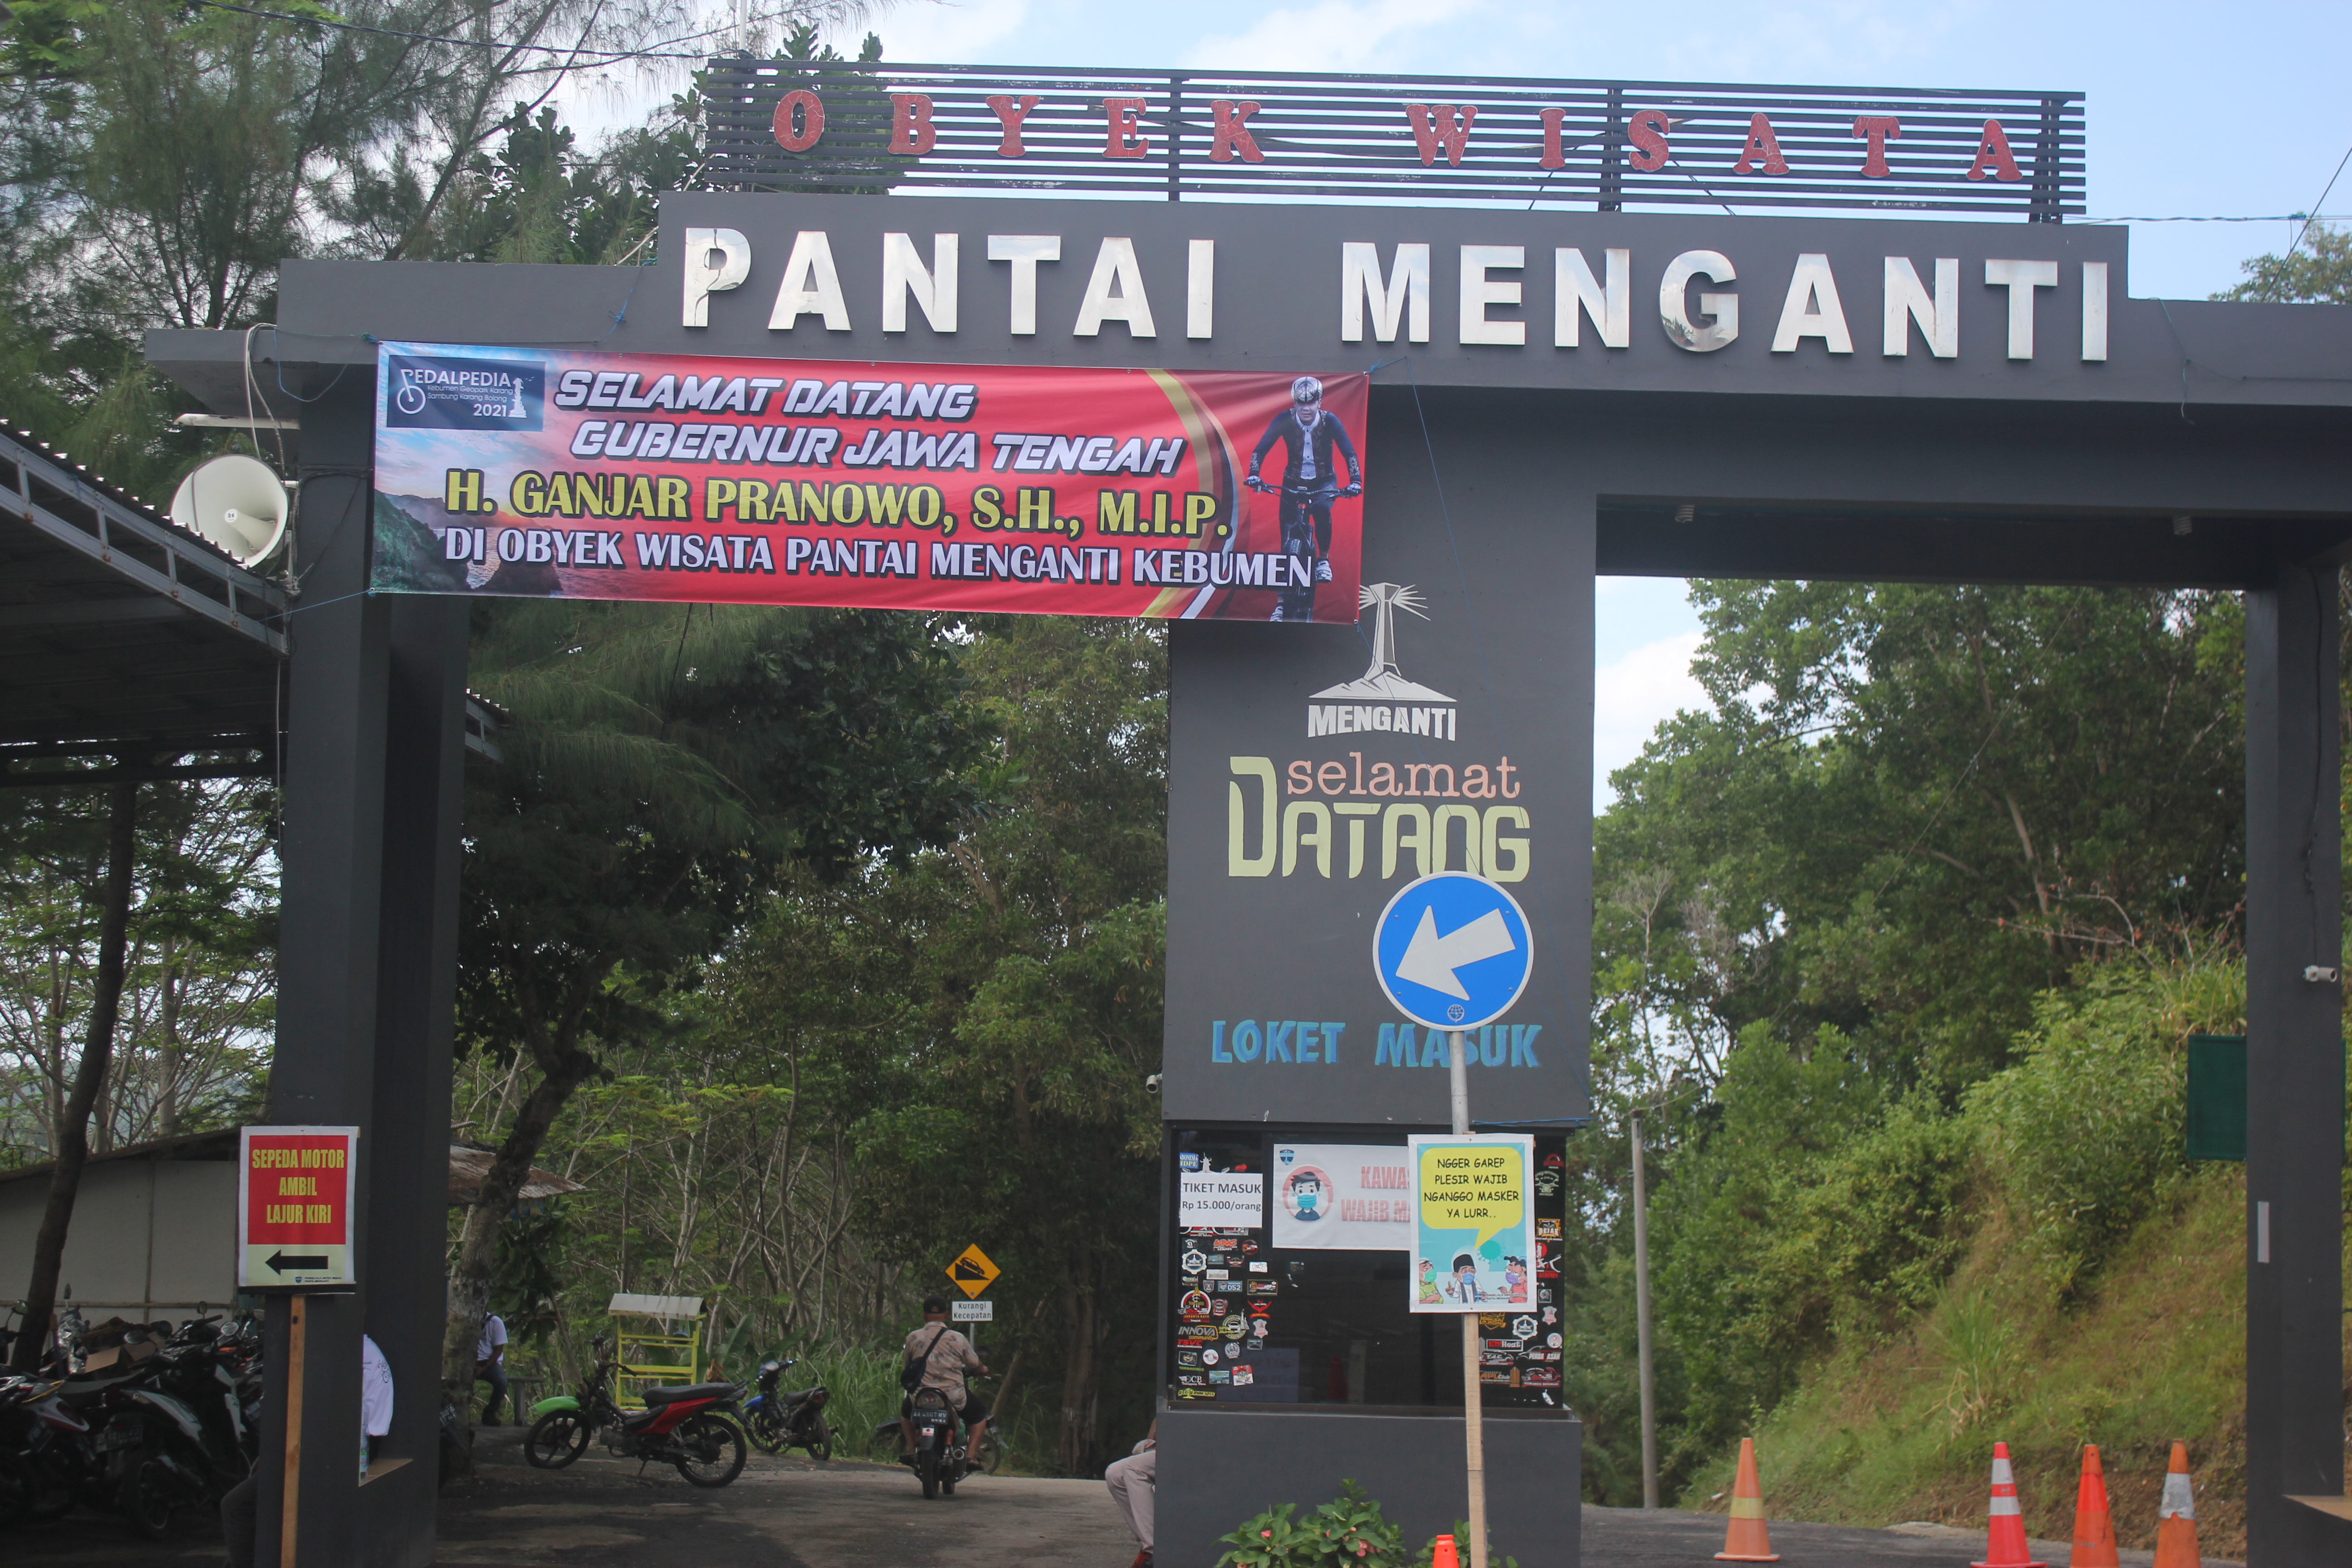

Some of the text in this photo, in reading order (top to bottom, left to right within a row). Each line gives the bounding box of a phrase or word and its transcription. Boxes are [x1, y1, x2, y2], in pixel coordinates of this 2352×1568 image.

[773, 89, 2023, 182] OBYEK WISATA
[682, 227, 2107, 362] PANTAI MENGANTI
[460, 386, 489, 394] Geopark
[460, 393, 483, 402] Karang
[485, 395, 507, 403] Bolong
[555, 371, 976, 418] SELAMAT DATANG
[473, 403, 507, 417] 2021
[570, 421, 1184, 473] GUBERNUR JAWA TENGAH
[447, 471, 1230, 537] H. GANJAR PRANOWO, S.H., M.I.P.
[446, 528, 1312, 588] DI OBYEK WISATA PANTAI MENGANTI KEBUMEN
[1308, 705, 1456, 742] MENGANTI
[1287, 752, 1521, 799] selamat
[1212, 1019, 1543, 1068] LOKET MASUK
[252, 1149, 345, 1169] SEPEDA MOTOR
[1437, 1157, 1505, 1169] NGGER GAREP
[279, 1177, 318, 1196] AMBIL
[1361, 1166, 1410, 1189] KAWA
[1435, 1174, 1508, 1185] PLESIR WAJIB
[1182, 1182, 1262, 1194] TIKET MASUK
[1424, 1191, 1520, 1202] NGANGGO MASKER
[266, 1205, 332, 1224] LAJUR KIRI
[1182, 1200, 1261, 1212] Rp 15.000/orang
[1340, 1199, 1411, 1222] WAJIB M
[1447, 1208, 1496, 1218] YA LURR..
[959, 1302, 987, 1310] Kurangi
[954, 1312, 992, 1320] Kecepatan
[1178, 1326, 1215, 1335] INNOVA
